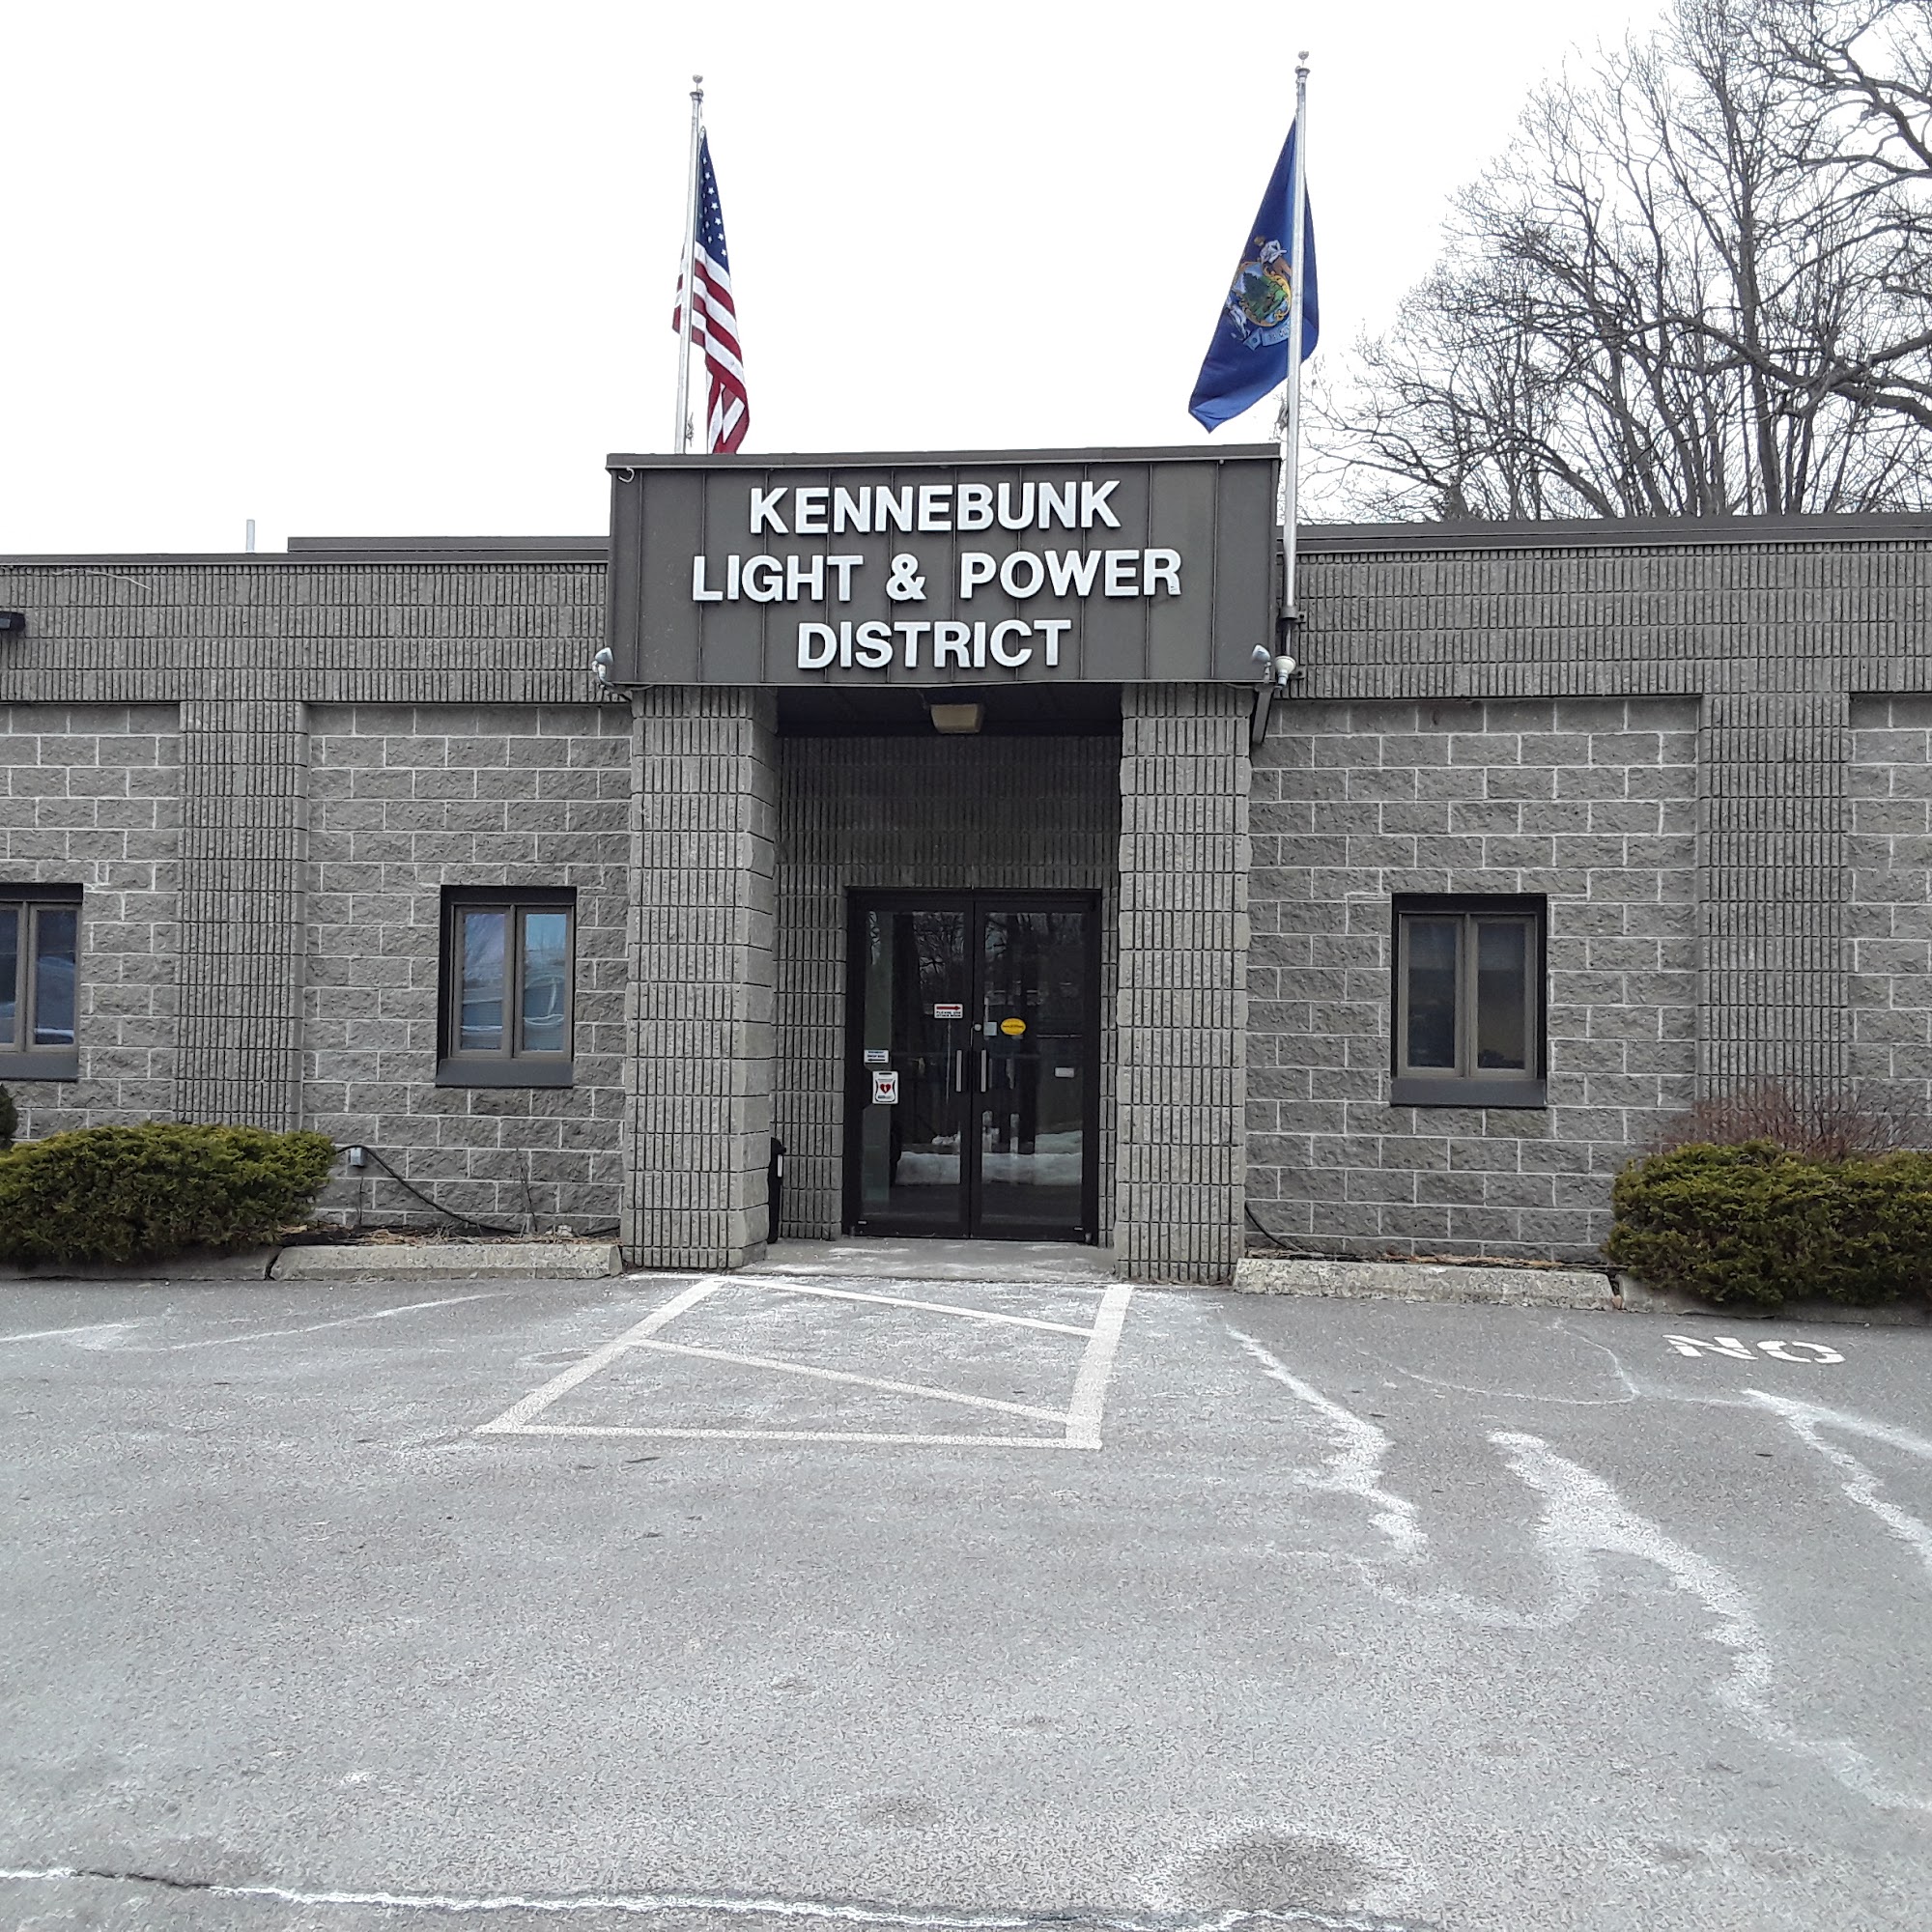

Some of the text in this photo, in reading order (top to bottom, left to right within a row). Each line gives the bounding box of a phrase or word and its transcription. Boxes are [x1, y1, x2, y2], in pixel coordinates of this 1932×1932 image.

[750, 480, 1122, 534] KENNEBUNK
[692, 548, 1181, 603] LIGHT & POWER
[797, 619, 1072, 668] DISTRICT
[1662, 1334, 1846, 1364] NO
